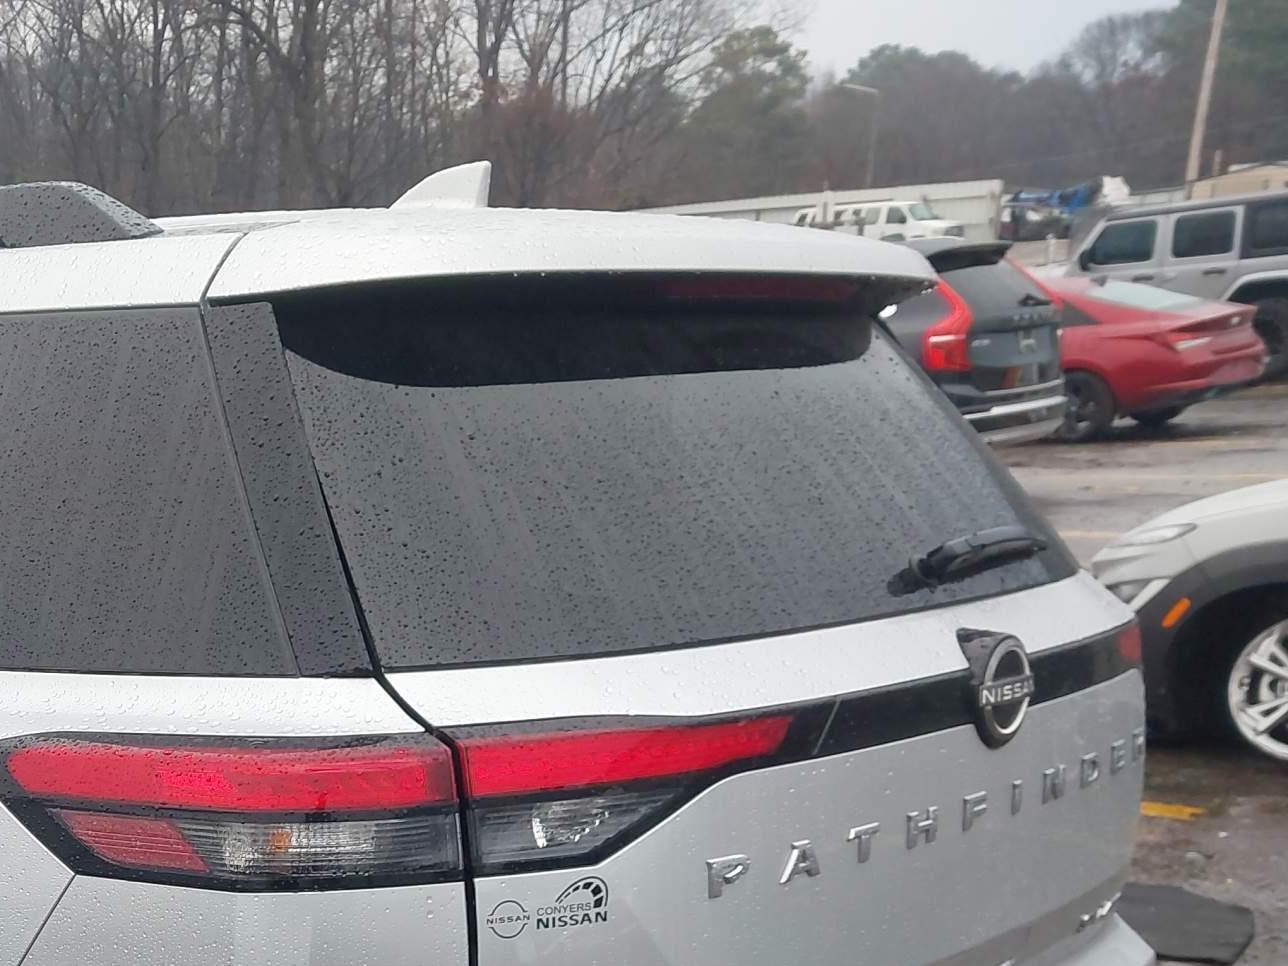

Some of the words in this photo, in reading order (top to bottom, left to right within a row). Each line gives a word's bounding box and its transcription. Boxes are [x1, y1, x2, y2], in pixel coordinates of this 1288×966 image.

[536, 902, 592, 917] CONYERS
[486, 914, 530, 925] NISSAN
[536, 910, 608, 930] NISSAN
